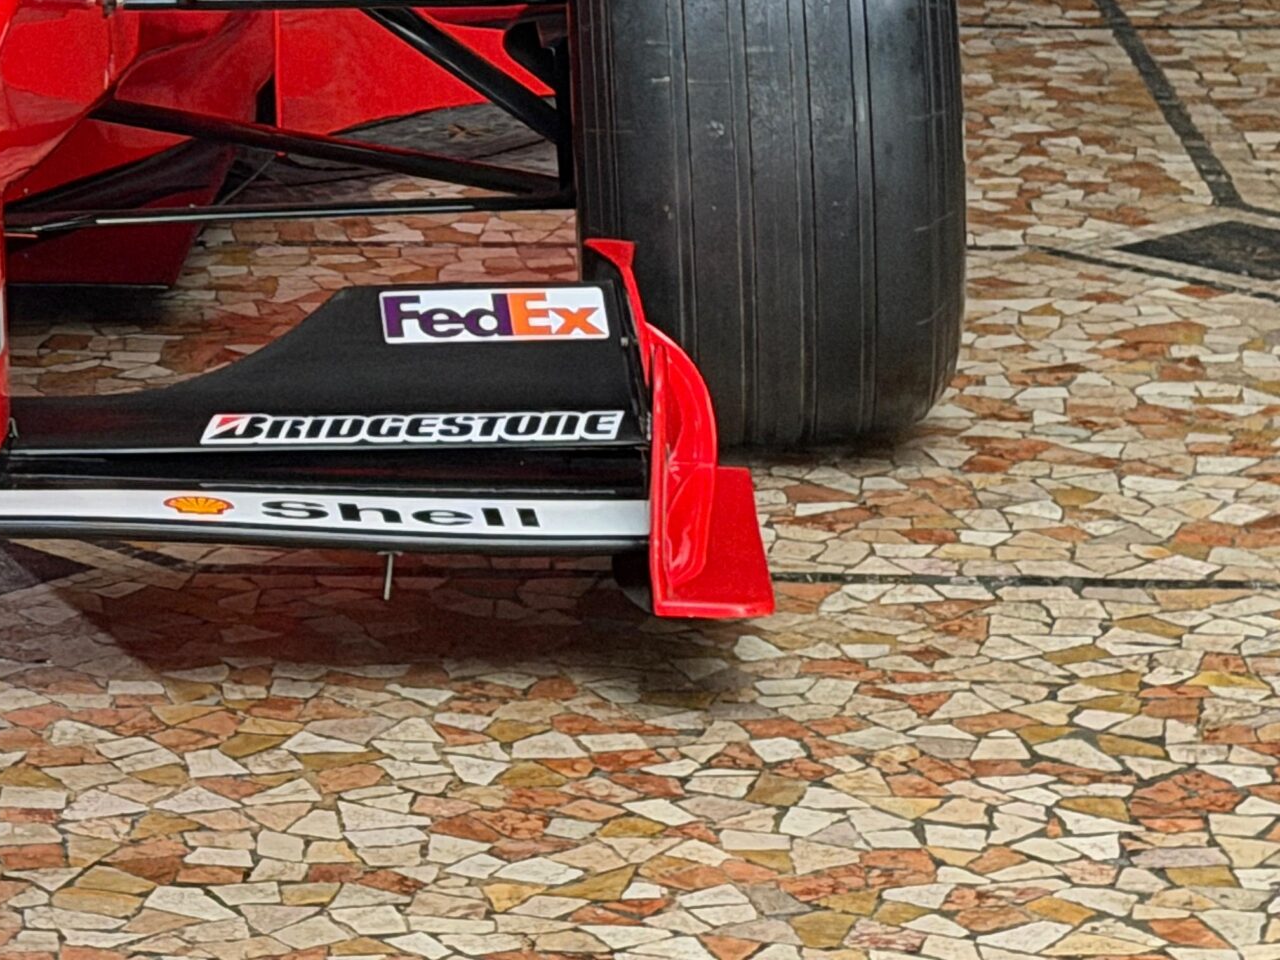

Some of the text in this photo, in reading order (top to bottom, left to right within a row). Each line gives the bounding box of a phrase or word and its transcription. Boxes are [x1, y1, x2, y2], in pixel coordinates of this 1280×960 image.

[383, 292, 605, 338] FedEx
[201, 410, 625, 445] BRIDGESTONE
[260, 499, 542, 529] Shell
